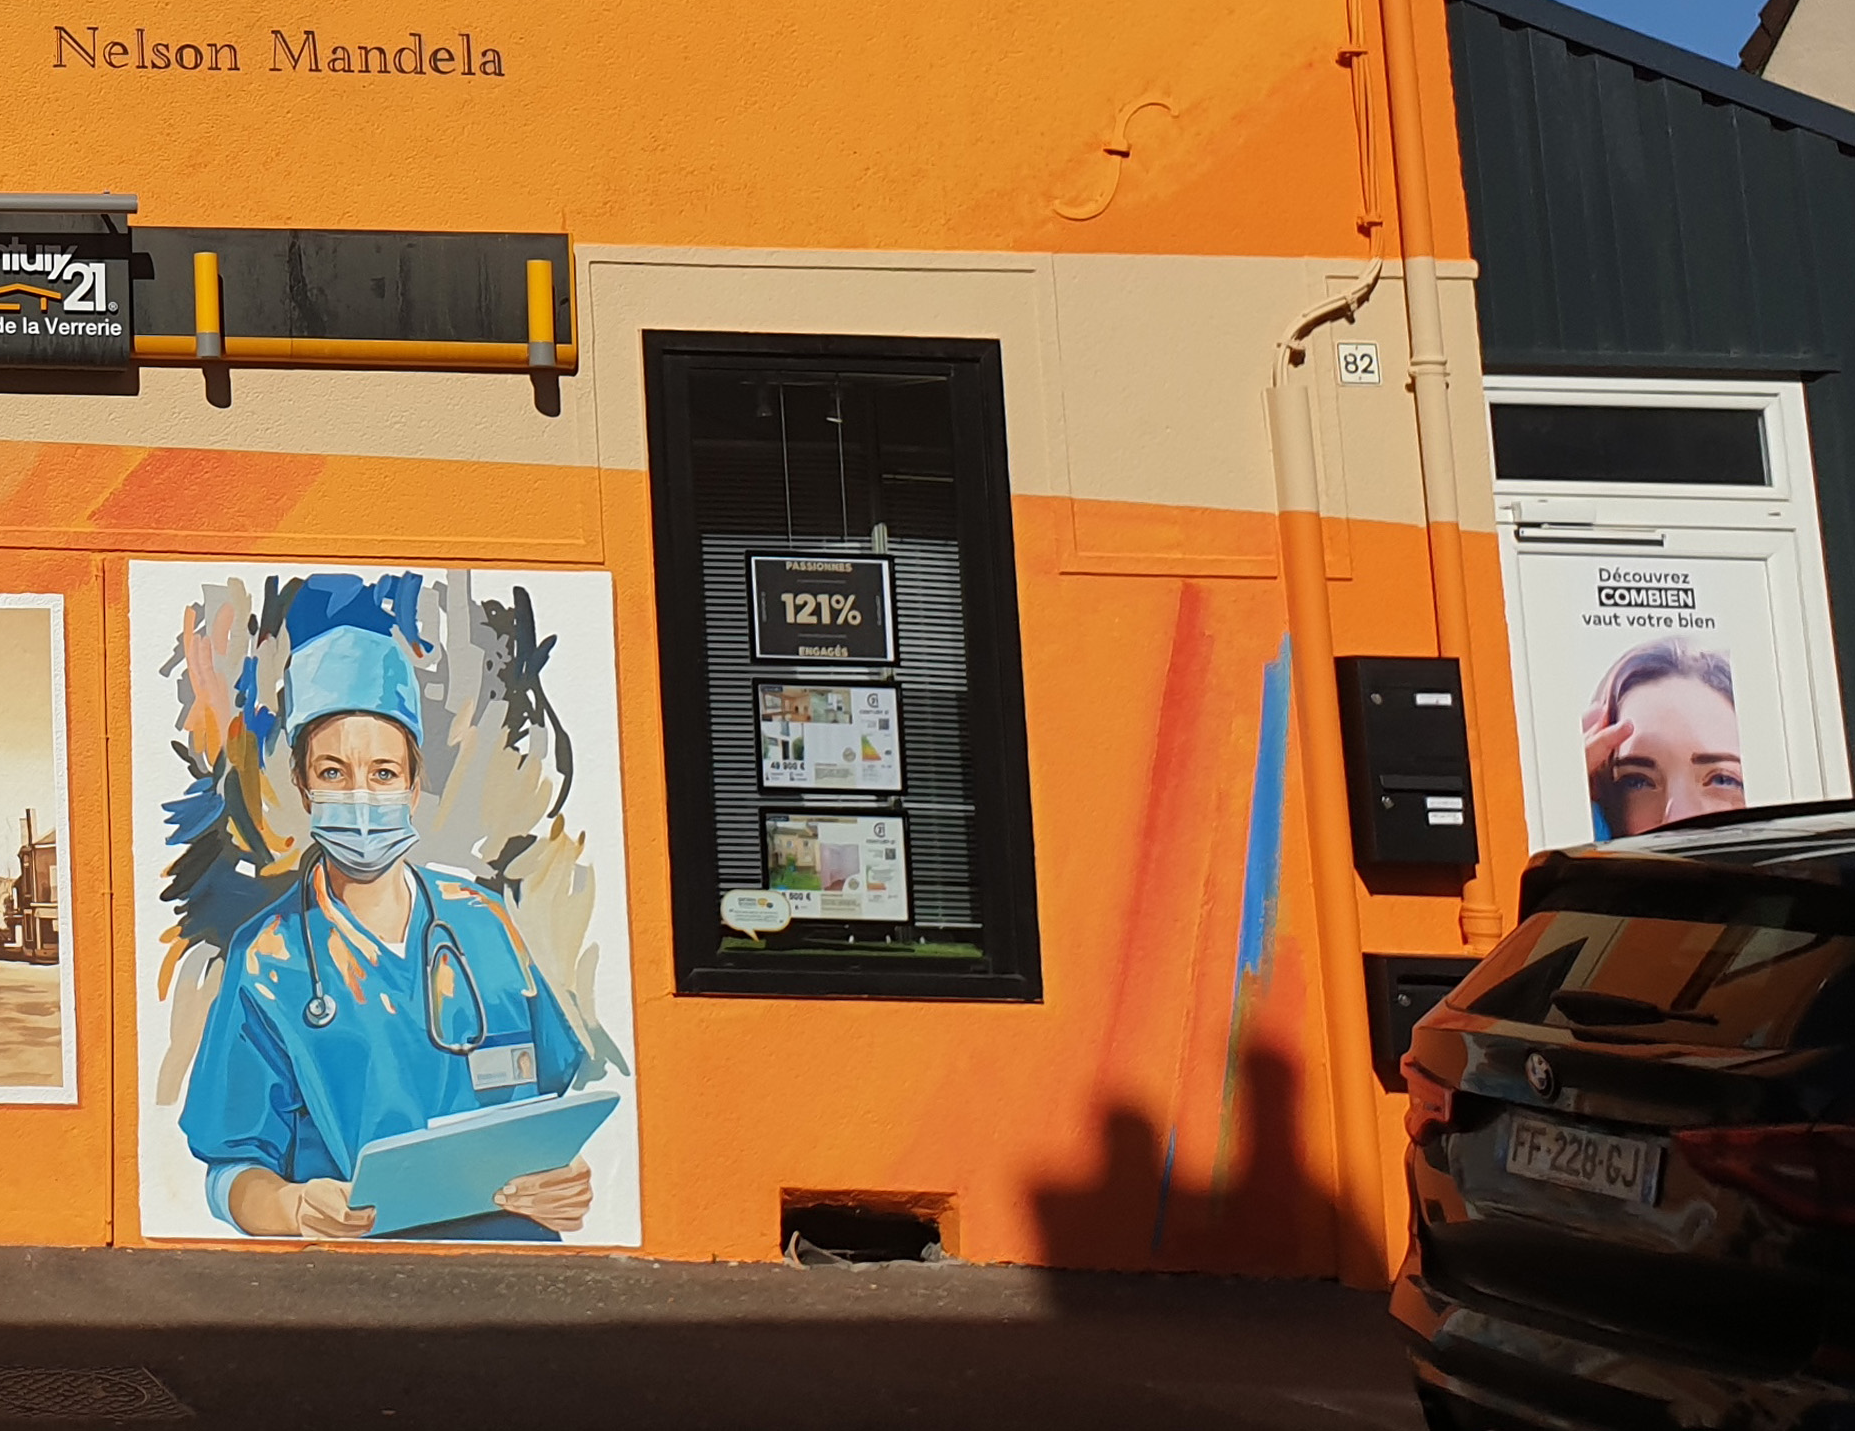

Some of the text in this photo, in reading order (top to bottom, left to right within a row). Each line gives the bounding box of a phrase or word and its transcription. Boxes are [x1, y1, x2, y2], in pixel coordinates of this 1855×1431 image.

[52, 25, 506, 77] Nelson Mandela
[62, 262, 106, 312] 21
[23, 317, 40, 335] la
[44, 318, 122, 336] Verrerie
[1343, 353, 1375, 374] 82
[1598, 567, 1690, 585] Découvrez
[1600, 588, 1694, 607] COMBIEN
[780, 592, 862, 626] 121%
[1582, 612, 1716, 629] vaut votre bien
